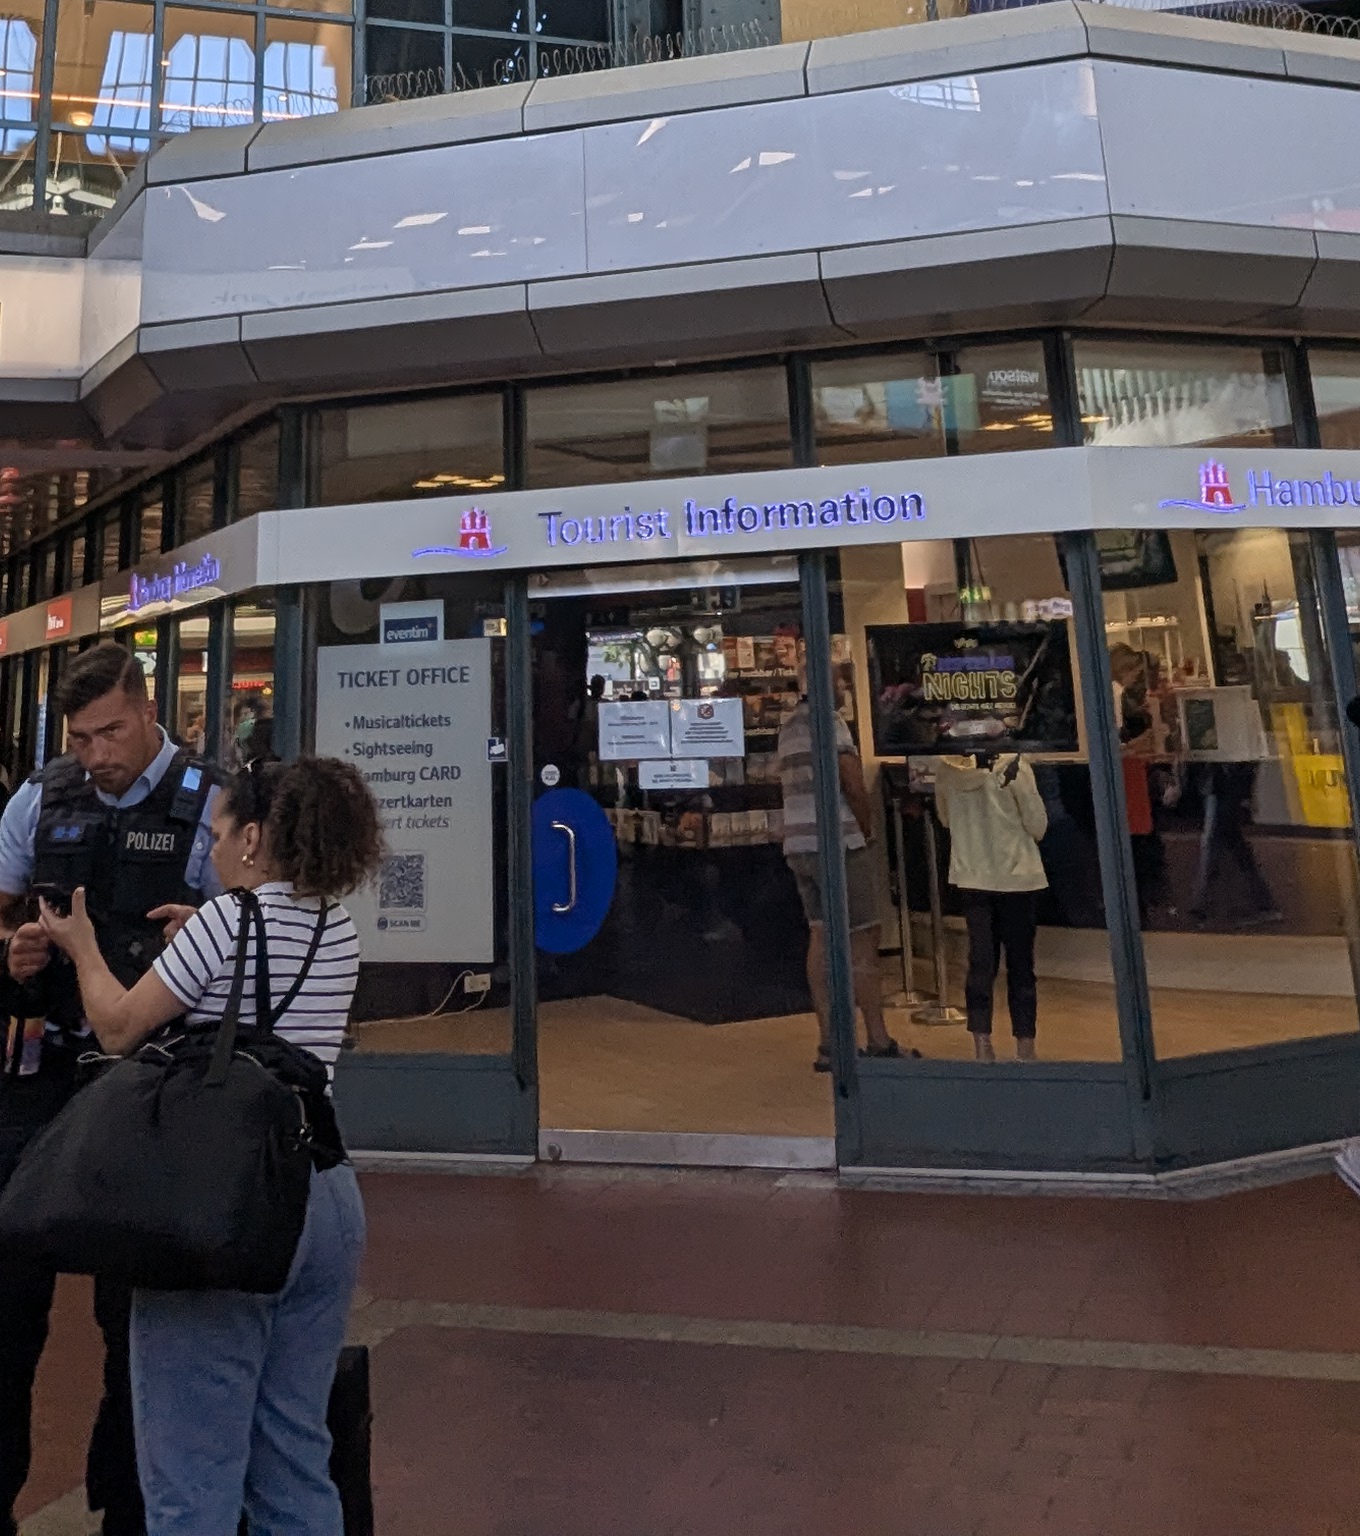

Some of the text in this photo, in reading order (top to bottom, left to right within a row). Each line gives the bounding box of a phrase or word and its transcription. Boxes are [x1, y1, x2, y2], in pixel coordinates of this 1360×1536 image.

[537, 486, 928, 547] Tourist Information
[385, 625, 429, 641] eventim
[337, 666, 470, 689] TICKET OFFICE
[922, 670, 1018, 702] NIGHTS
[352, 714, 452, 730] Musicaltickets
[353, 740, 434, 758] Sightseeing
[361, 765, 462, 785] amburg CARD
[378, 794, 453, 810] zertkarten
[406, 814, 450, 830] tickets
[125, 830, 175, 852] POLIZEI
